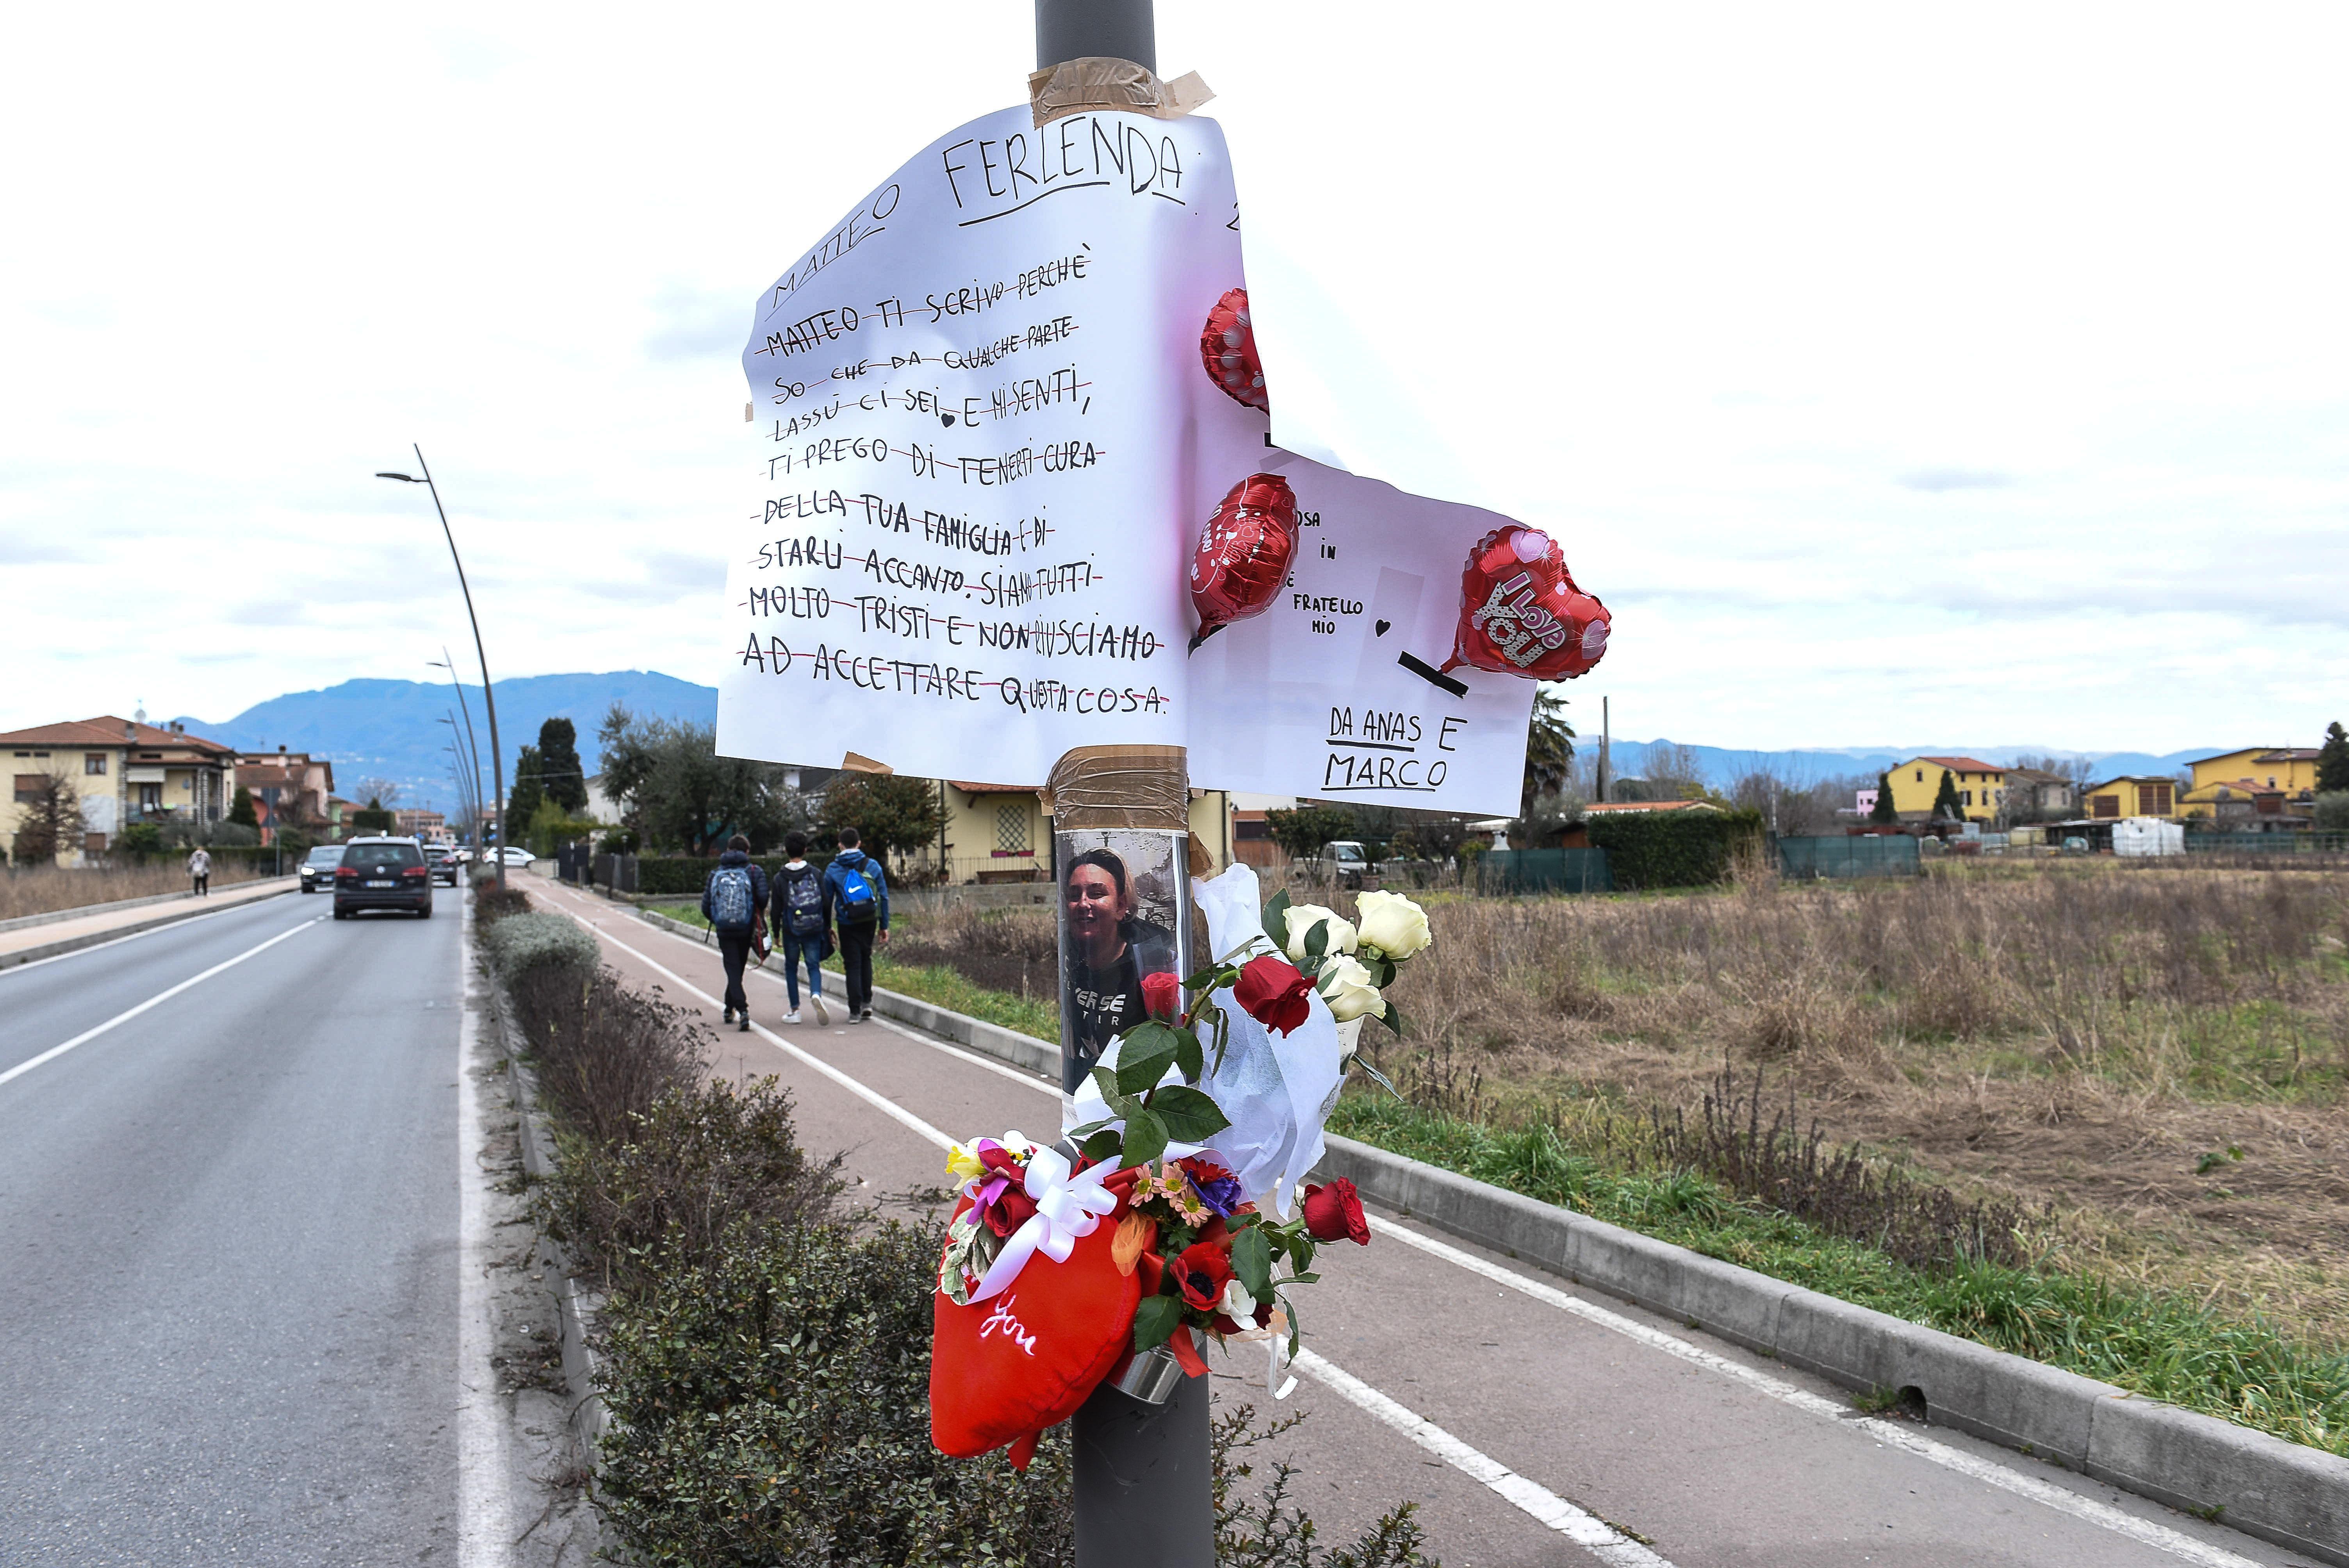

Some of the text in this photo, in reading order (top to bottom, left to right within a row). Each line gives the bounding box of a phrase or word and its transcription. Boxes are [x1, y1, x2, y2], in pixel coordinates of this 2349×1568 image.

[773, 184, 900, 308] MATTEO
[766, 307, 859, 357] MATTEO
[775, 316, 1073, 404] SO CHE DA QUALCHE PARTE
[964, 398, 982, 427] E
[804, 437, 888, 469] PREGO
[1044, 441, 1096, 472] CURA
[765, 490, 847, 524] DELLA
[860, 494, 910, 533] TUA
[750, 586, 829, 619] MOLTO
[947, 616, 963, 645] E
[979, 621, 1030, 650] NON
[1293, 593, 1363, 615] FRATELLO
[743, 633, 791, 675] AD
[813, 643, 983, 700] ACCETTARE
[1330, 707, 1468, 751] DA ANAS E
[1324, 753, 1447, 786] MARCO
